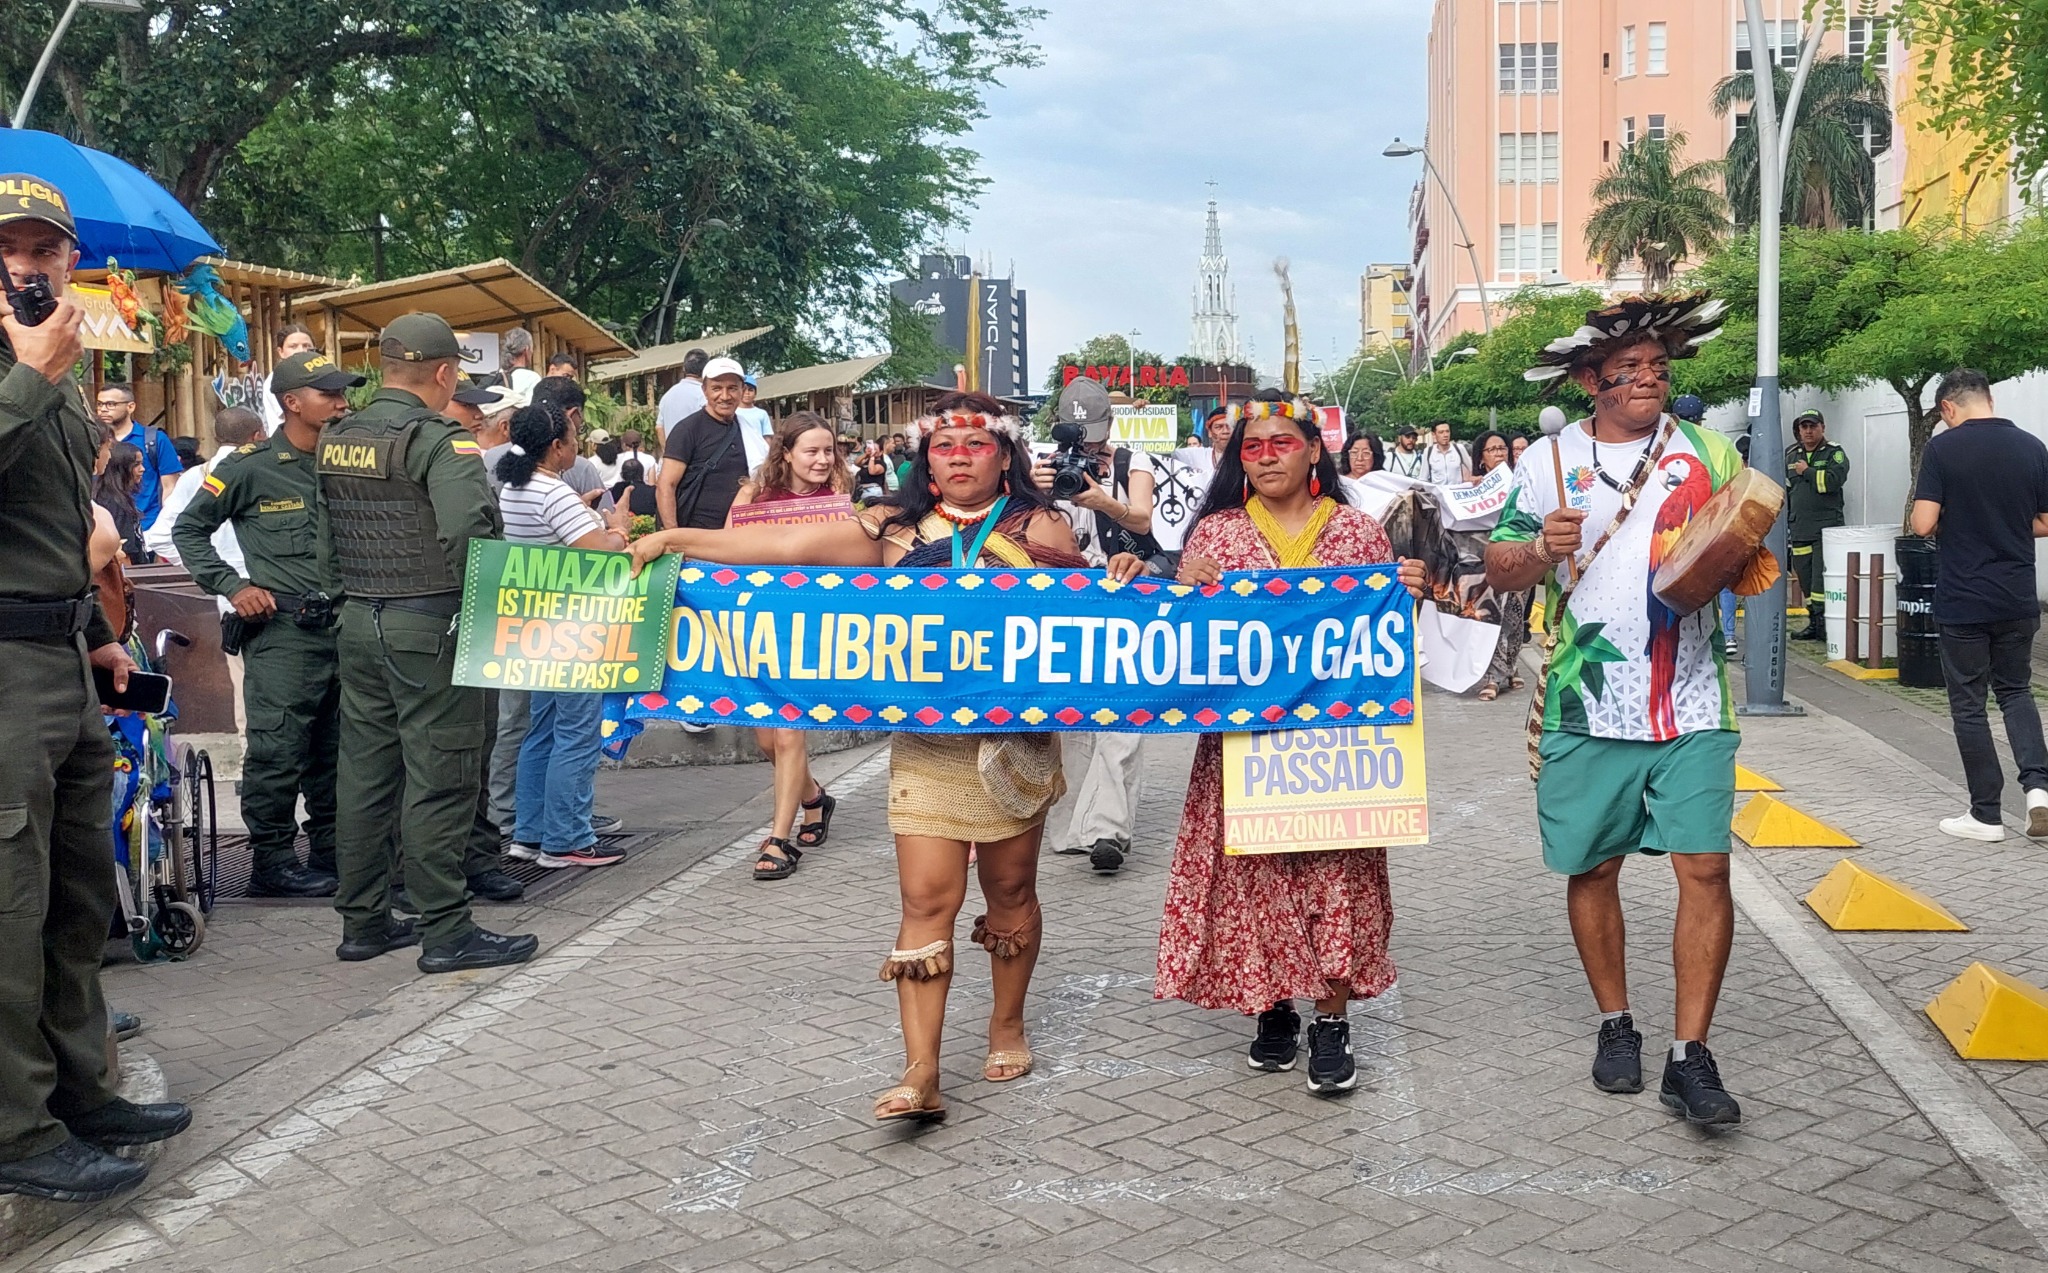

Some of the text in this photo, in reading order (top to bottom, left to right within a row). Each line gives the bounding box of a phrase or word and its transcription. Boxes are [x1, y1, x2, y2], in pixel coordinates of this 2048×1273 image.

[1063, 366, 1190, 387] BAVARIA
[1117, 417, 1169, 439] VIVA
[322, 444, 376, 469] POLICIA
[1462, 491, 1507, 513] VIDA
[501, 546, 653, 596] AMAZON
[496, 588, 648, 623] IS THE FUTURE
[493, 617, 638, 662] FOSSIL
[789, 612, 944, 682] LIBRE
[951, 630, 993, 671] DE
[1002, 603, 1273, 686] PETRÓLEO
[1282, 635, 1303, 674] Y
[1311, 610, 1405, 681] GAS
[503, 658, 624, 689] IS THE PAST
[1244, 747, 1403, 797] PASSADO
[1226, 808, 1422, 845] AMAZÔNIA LIVRE
